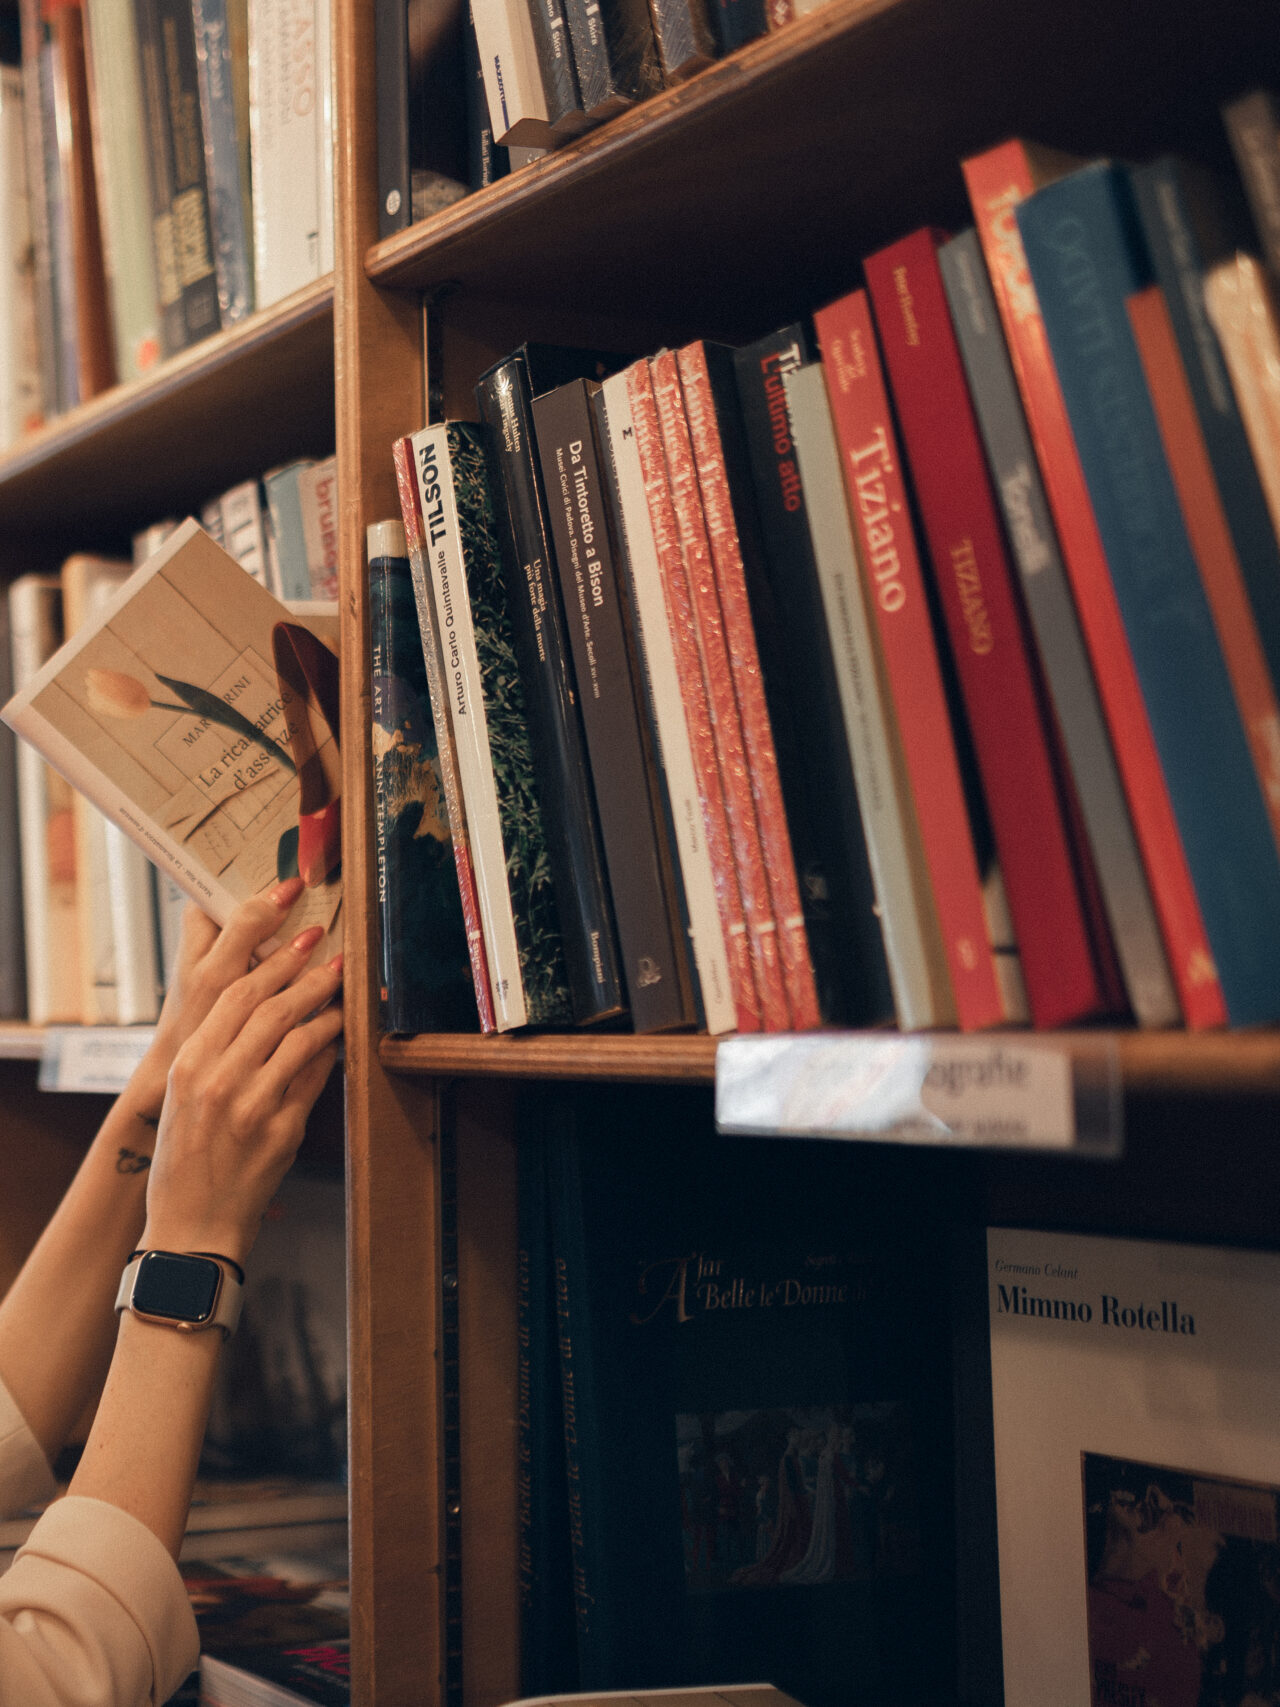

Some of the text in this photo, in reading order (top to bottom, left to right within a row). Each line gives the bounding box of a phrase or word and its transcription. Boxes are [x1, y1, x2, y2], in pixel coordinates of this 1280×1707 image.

[552, 31, 562, 58] Skira
[587, 17, 598, 46] Skira
[501, 410, 513, 452] Tinguely
[511, 418, 521, 453] Hulten
[760, 354, 792, 455] L'ultimo
[778, 460, 801, 512] atto
[556, 448, 564, 473] Musei
[419, 443, 447, 548] TILSON
[560, 474, 569, 496] Civici
[566, 506, 574, 538] Padova.
[569, 440, 604, 607] Da Tintoretto a Bison
[850, 426, 907, 613] Tiziano
[570, 538, 582, 573] Disegni
[533, 559, 548, 612] Una magia
[575, 571, 585, 584] del
[523, 564, 546, 663] più forte della morte
[577, 585, 587, 612] Museo
[951, 538, 995, 655] TIZIANO
[438, 550, 468, 715] Arturo Carlo Quintavalle
[582, 613, 591, 639] d'Arte.
[373, 645, 382, 677] THE
[586, 641, 597, 668] Secoli
[223, 675, 252, 705] RINI
[374, 685, 383, 716] ART
[198, 692, 295, 788] La ricaatrice
[375, 755, 384, 794] ANN
[376, 803, 387, 903] TEMPLETON
[591, 931, 606, 984] Bompiani
[993, 1258, 1079, 1281] Germano Celant
[696, 1277, 756, 1311] Belle
[760, 1283, 775, 1307] le
[776, 1279, 849, 1306] Donne
[996, 1283, 1197, 1336] Mimmo Rotella
